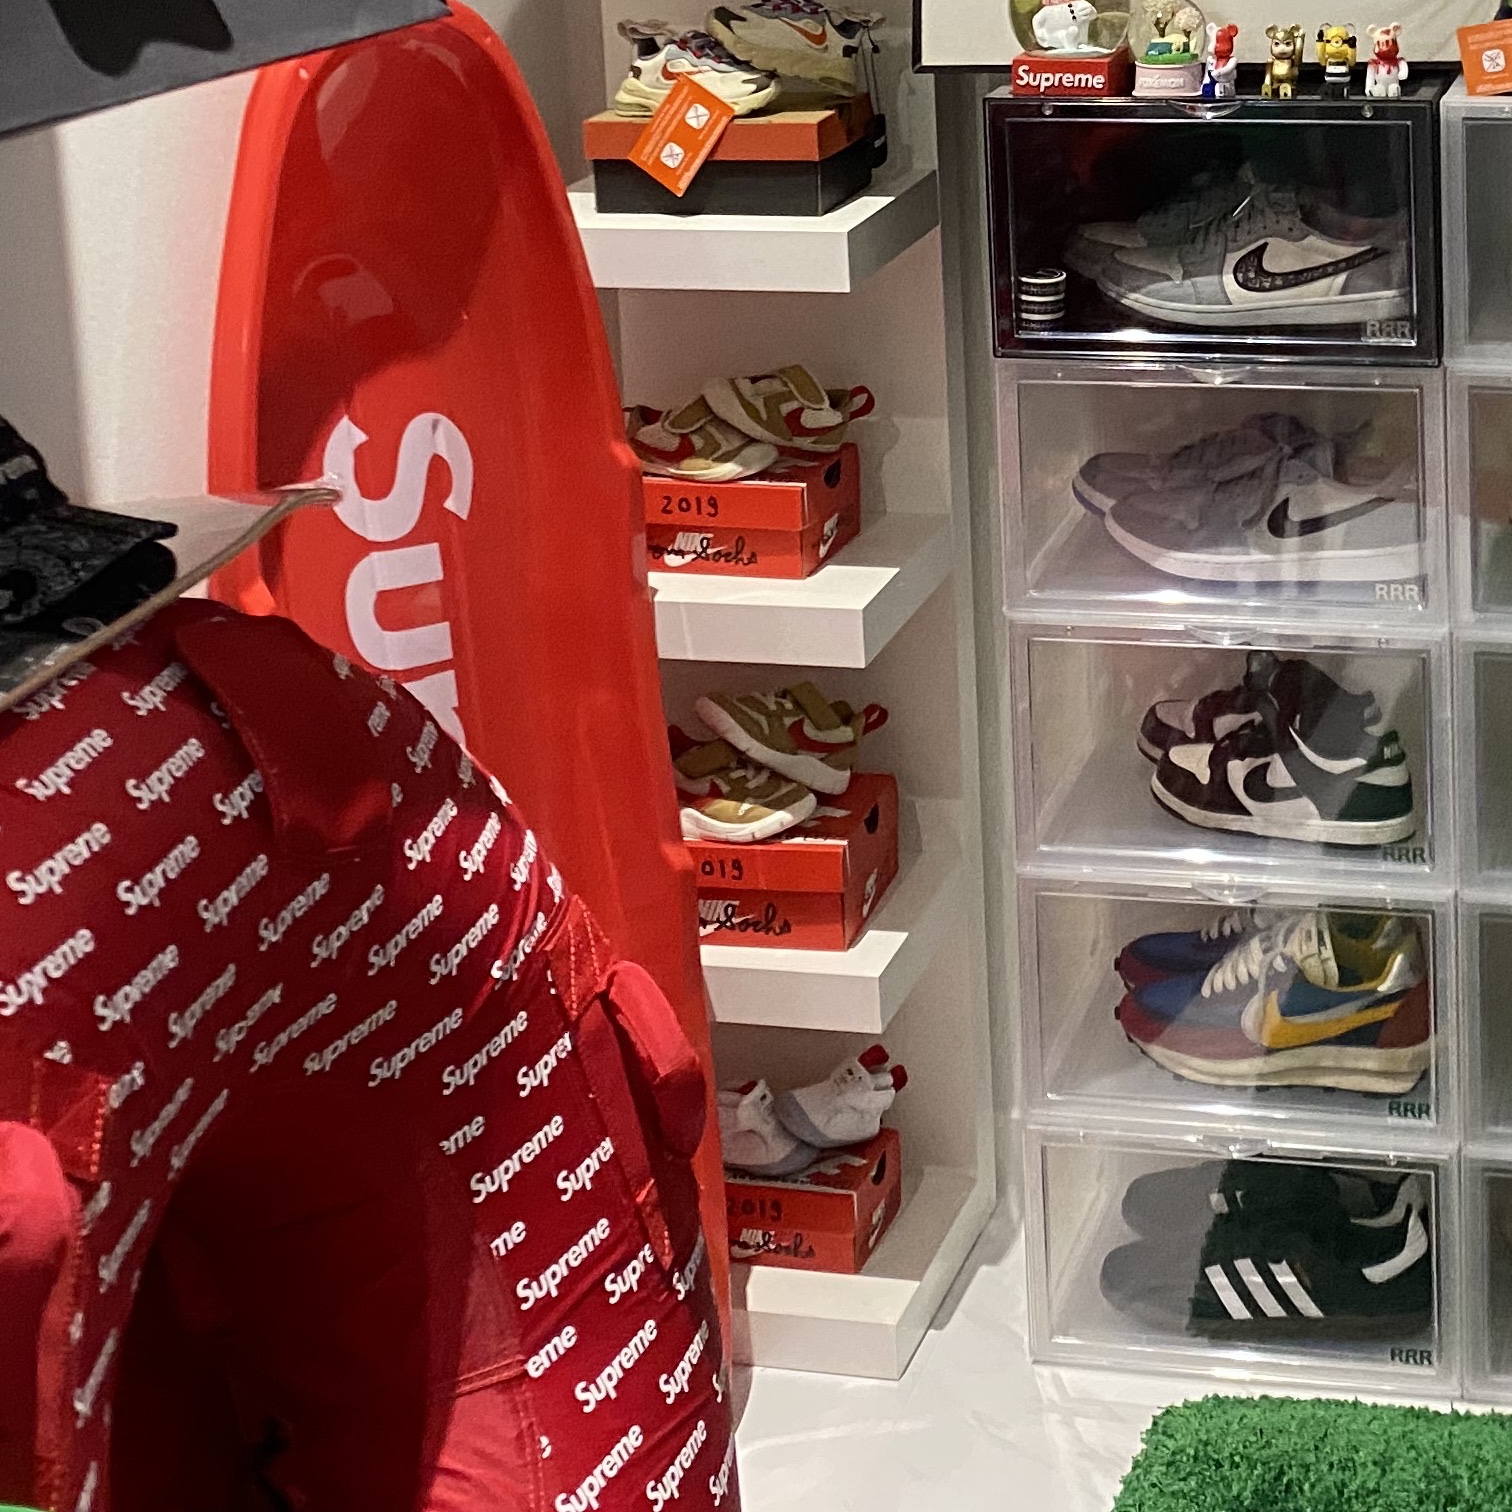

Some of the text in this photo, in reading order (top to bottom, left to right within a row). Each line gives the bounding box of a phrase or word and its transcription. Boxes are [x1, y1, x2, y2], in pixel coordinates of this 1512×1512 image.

[1016, 65, 1105, 92] Supreme
[660, 494, 719, 518] 2019
[1375, 583, 1419, 601] RRR
[15, 728, 114, 802] Supreme
[125, 738, 206, 811] Supreme
[403, 797, 458, 871] Supreme
[459, 811, 502, 882] Supreme
[701, 858, 743, 881] 019
[367, 894, 443, 977] Supreme
[428, 904, 499, 986] Supreme
[93, 944, 180, 1032] Supreme
[303, 1000, 397, 1076] Supreme
[367, 1007, 463, 1088] Supreme
[442, 1010, 528, 1096] Supreme
[1388, 1100, 1431, 1118] RRR
[470, 1115, 564, 1204] Supreme
[516, 1217, 611, 1310] Supreme
[526, 1325, 578, 1379] eme
[574, 1319, 658, 1413] Supreme
[658, 1320, 710, 1405] Supreme
[1390, 1348, 1433, 1366] RRR
[555, 1424, 645, 1512] Supreme
[646, 1420, 707, 1512] Supreme
